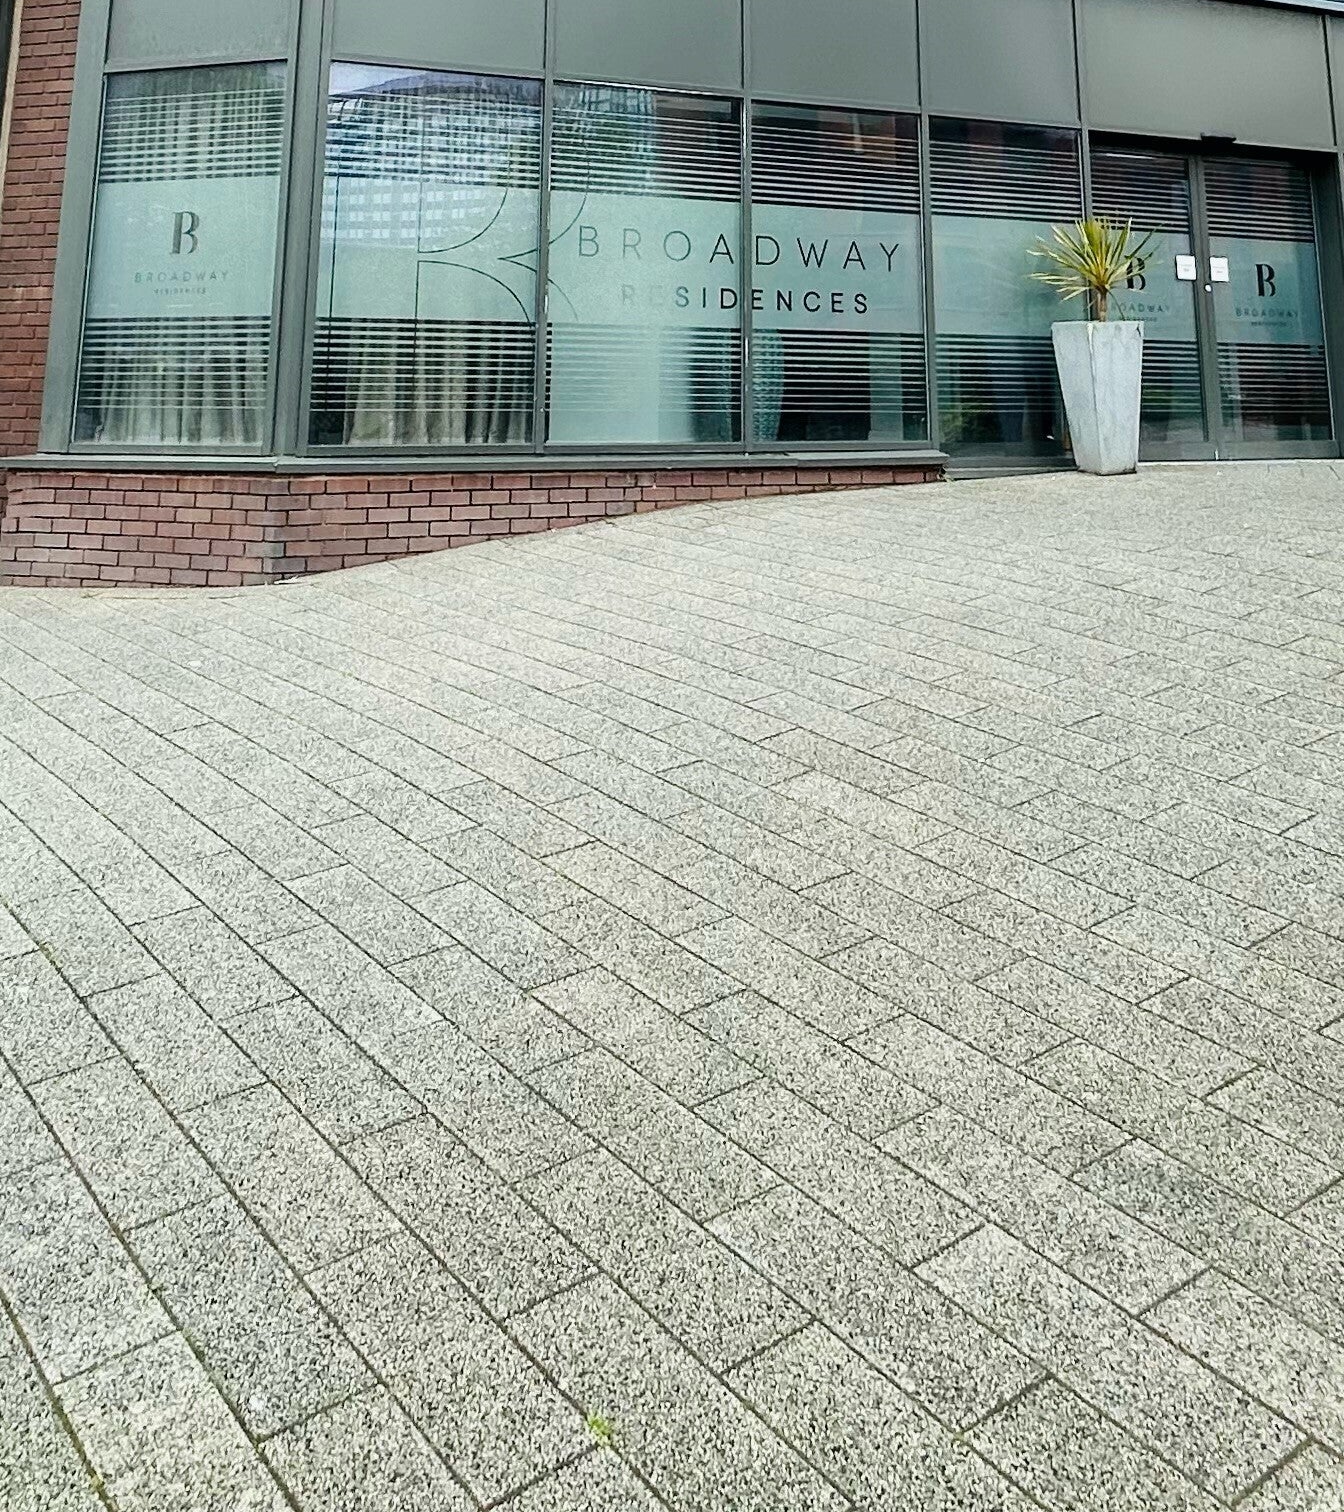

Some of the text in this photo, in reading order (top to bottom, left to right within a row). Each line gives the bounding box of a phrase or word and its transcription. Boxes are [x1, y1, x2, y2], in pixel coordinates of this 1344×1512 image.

[169, 210, 200, 255] B
[578, 225, 900, 272] BROADWAY
[134, 270, 229, 284] BROADWAY
[1255, 263, 1276, 297] B
[620, 284, 869, 314] RESIDENCES
